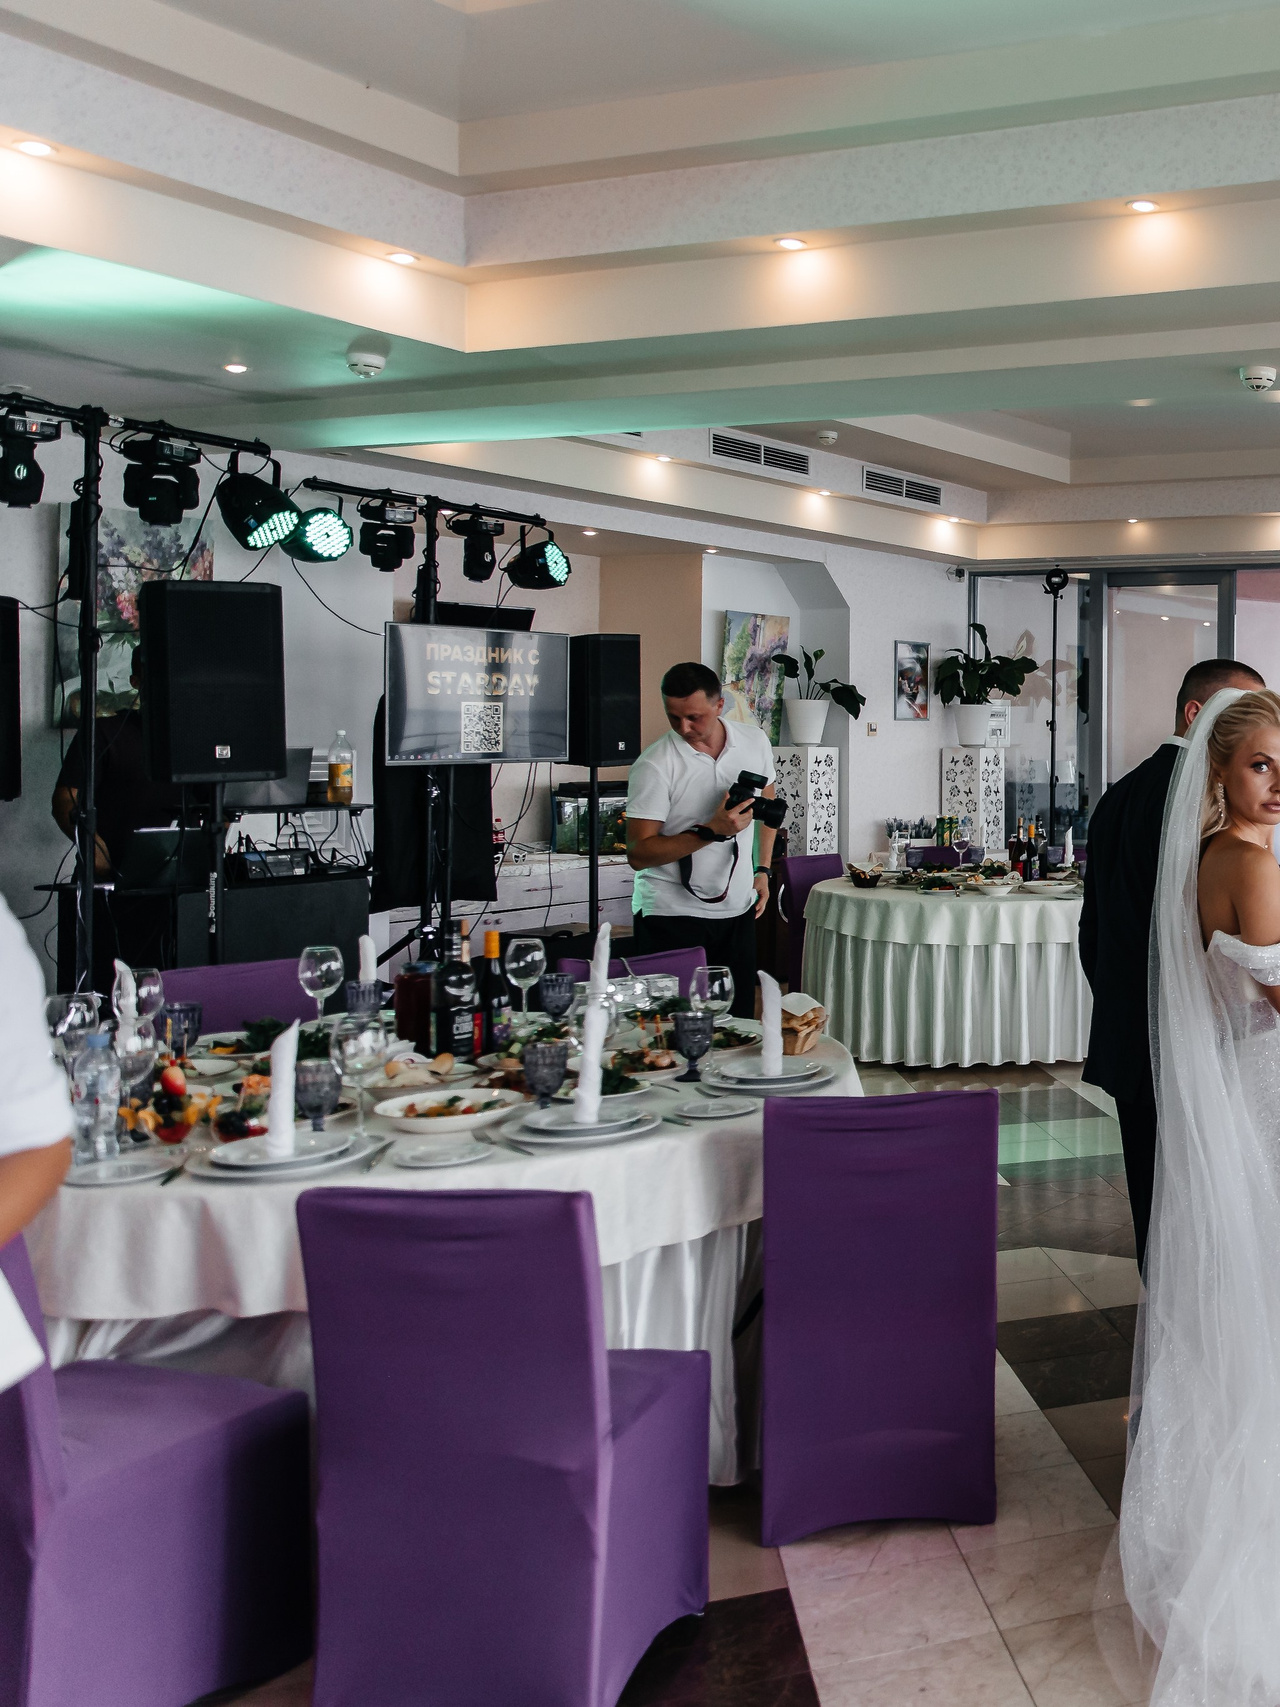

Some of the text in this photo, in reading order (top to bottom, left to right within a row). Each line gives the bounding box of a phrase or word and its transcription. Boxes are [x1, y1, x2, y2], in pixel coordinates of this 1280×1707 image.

[426, 643, 540, 666] ПРАЗДНИК С
[427, 671, 540, 696] STARDAY
